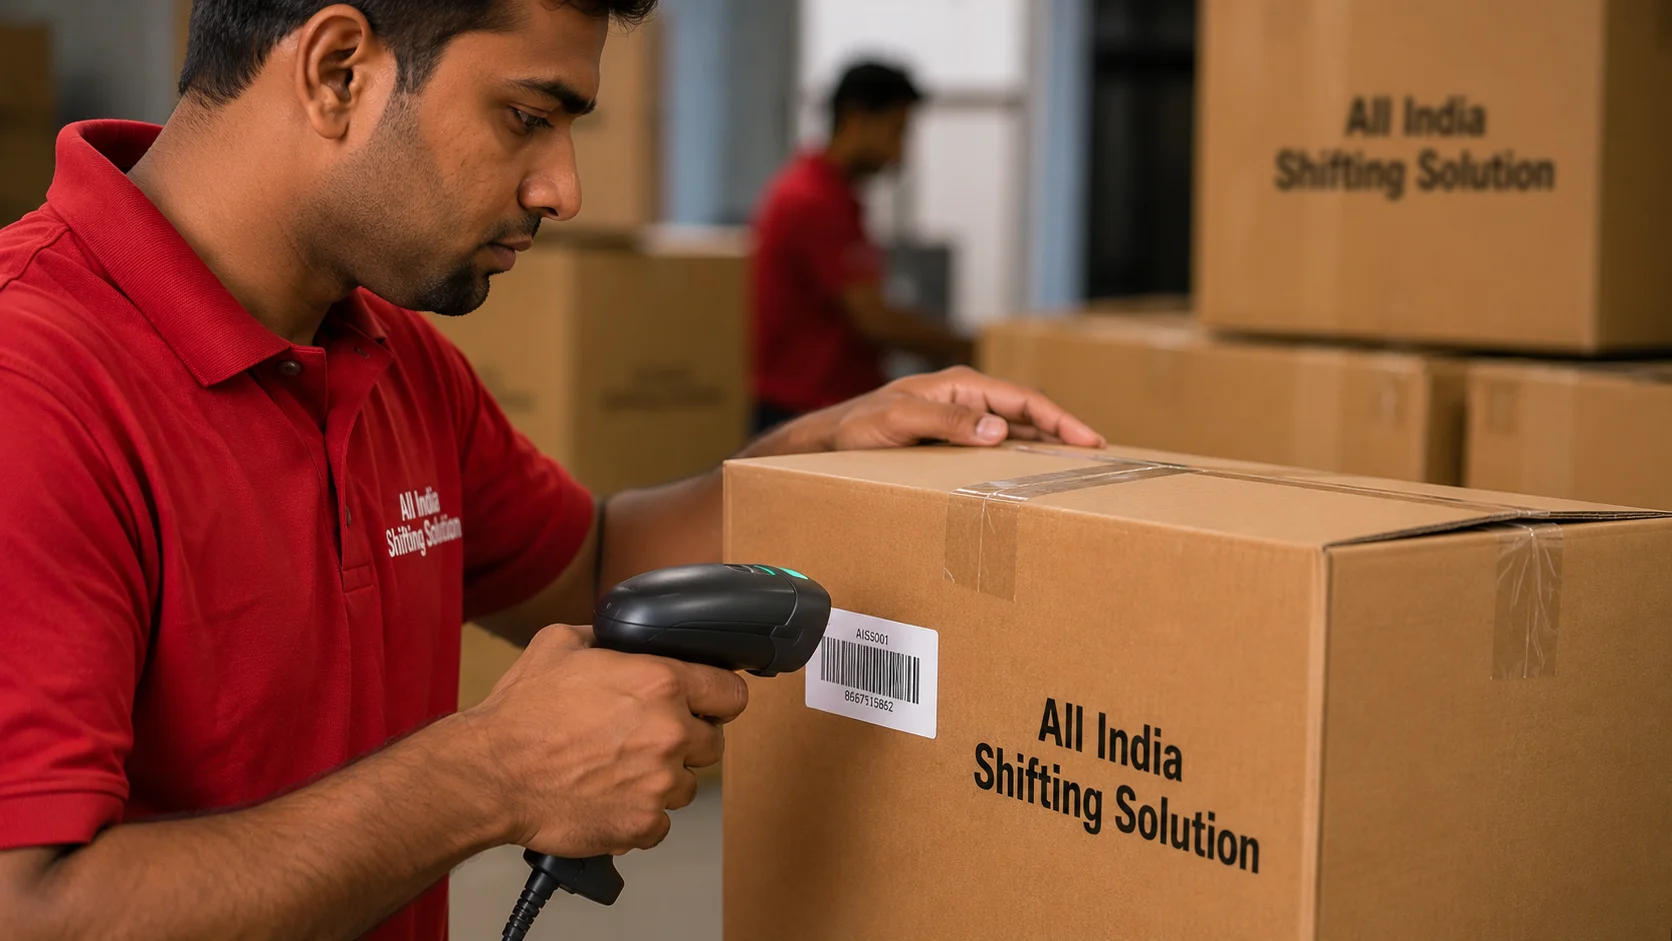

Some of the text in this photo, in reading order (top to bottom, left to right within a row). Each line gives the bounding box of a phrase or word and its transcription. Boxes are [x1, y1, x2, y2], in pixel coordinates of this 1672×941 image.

[1345, 95, 1486, 137] All India
[1274, 148, 1556, 200] Shifting Solution
[399, 486, 440, 521] All India
[386, 525, 426, 557] Shifting
[856, 629, 888, 645] AISS001
[1038, 697, 1182, 782] All India
[974, 742, 1259, 874] Shifting Solution
